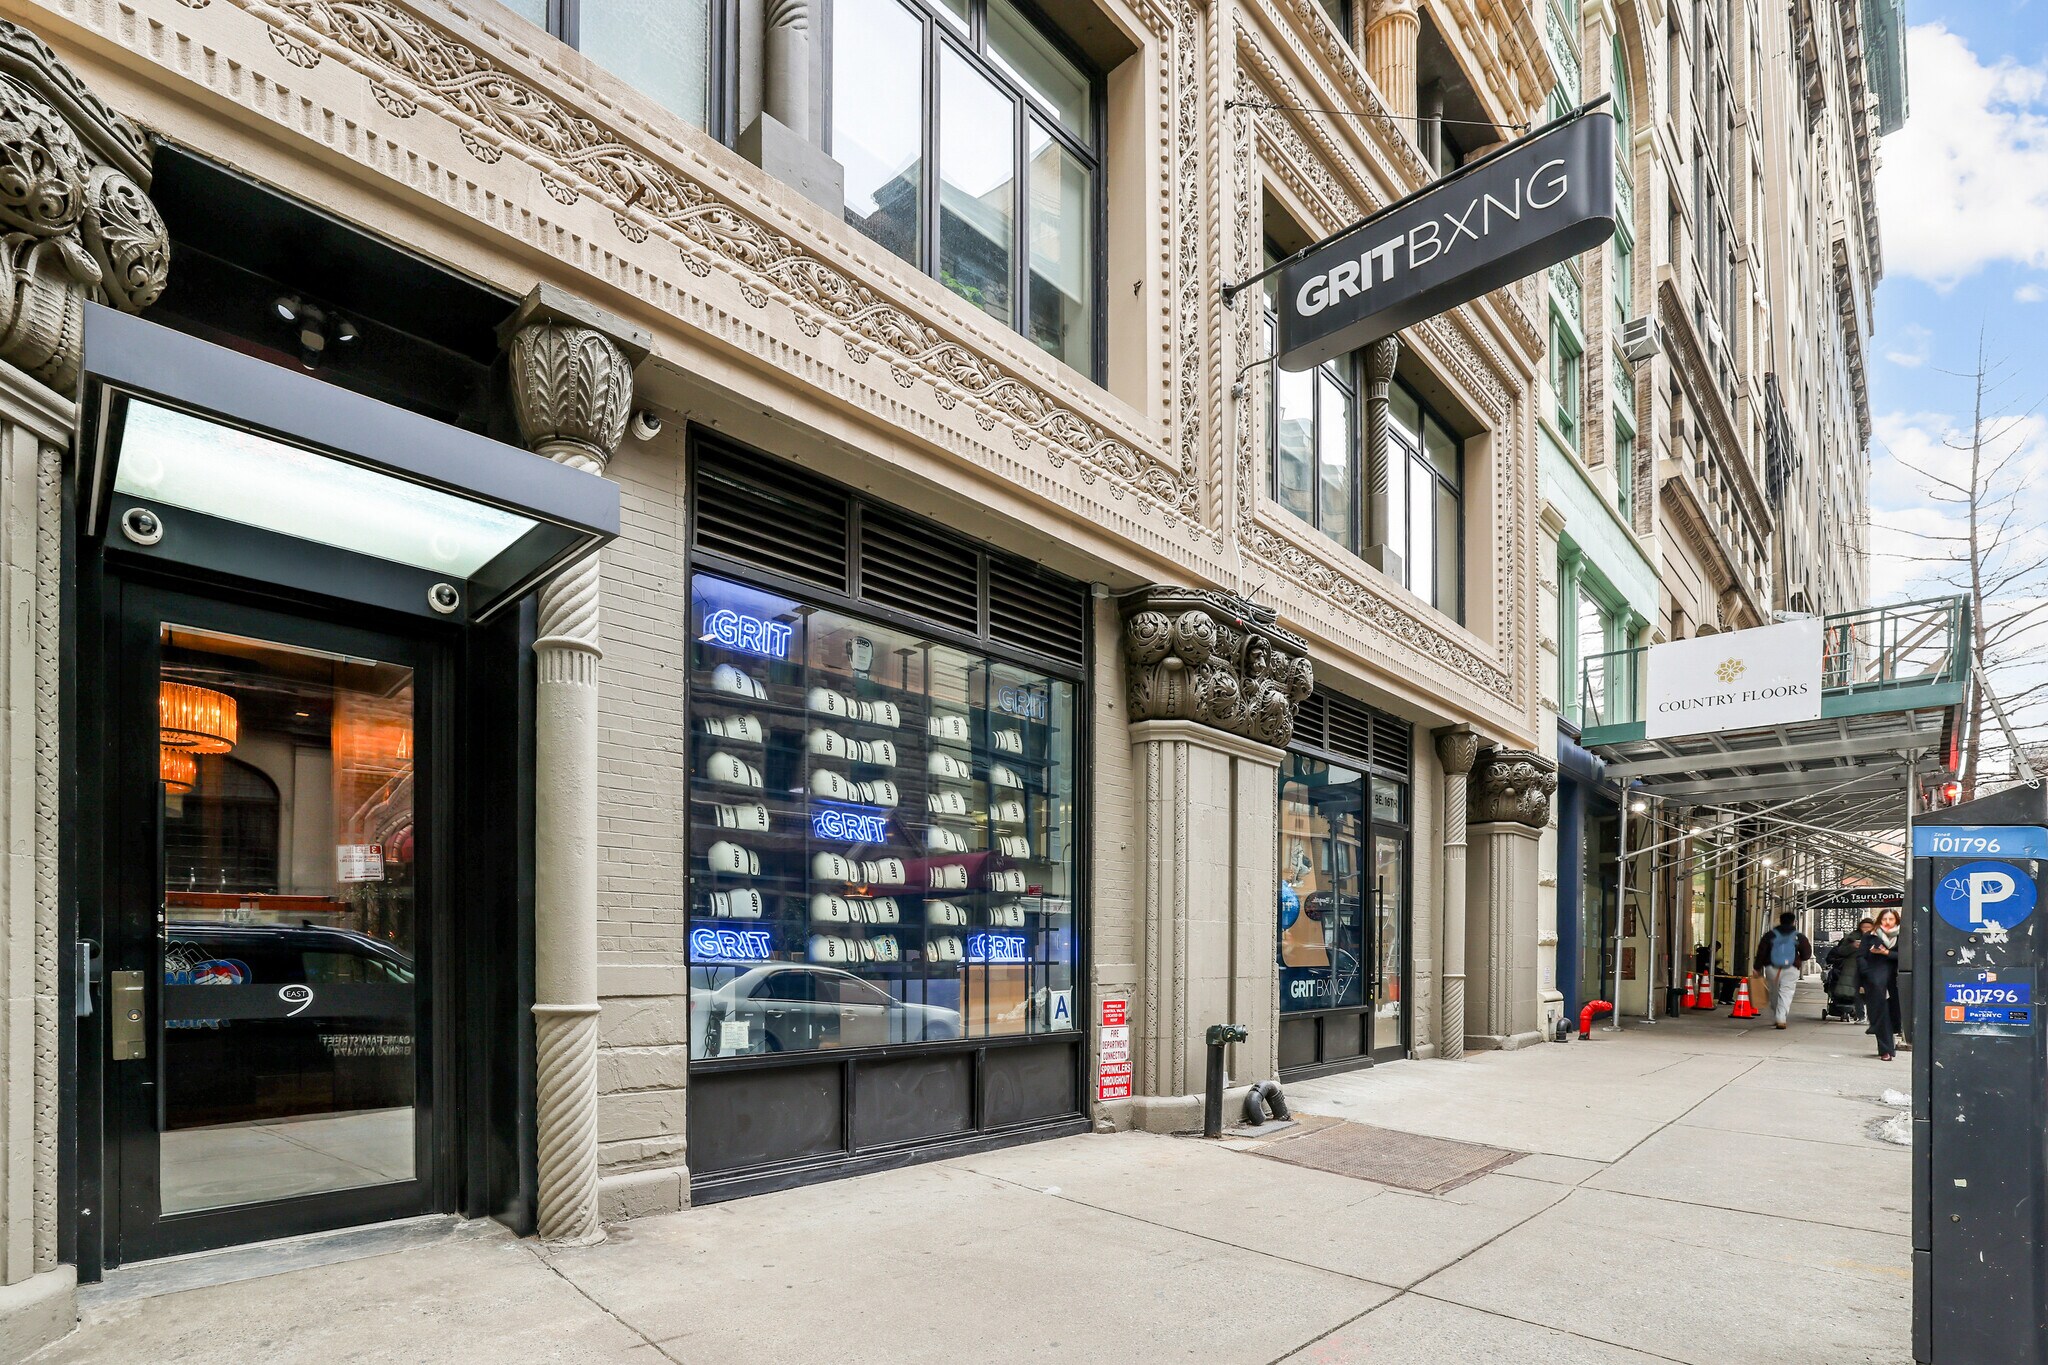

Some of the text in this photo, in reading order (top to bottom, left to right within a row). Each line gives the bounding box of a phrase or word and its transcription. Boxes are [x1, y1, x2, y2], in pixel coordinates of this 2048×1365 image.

[713, 609, 792, 657] GRIT
[998, 685, 1048, 720] GRIT
[1658, 683, 1808, 713] COUNTRY FLOORS
[884, 704, 893, 722] GRIT
[882, 743, 890, 761] GRIT
[884, 783, 892, 801] GRIT
[757, 806, 765, 826] GRIT
[821, 810, 886, 843] GRIT
[1933, 838, 2001, 853] 101796
[889, 862, 897, 879] GRIT
[1970, 872, 2015, 923] P
[886, 901, 894, 919] GRIT
[693, 928, 770, 958] GRIT
[885, 939, 893, 957] GRIT
[977, 933, 1025, 959] GRIT
[1290, 978, 1345, 999] GRIT BXNG
[1956, 989, 2019, 1003] 101796
[1055, 995, 1069, 1019] A
[1110, 1029, 1119, 1038] FIRE
[1102, 1040, 1127, 1050] DEPARTMENT
[1103, 1051, 1126, 1061] CONNECTION
[1101, 1064, 1131, 1075] SPRINKLERS
[1101, 1075, 1130, 1086] THROUGHOUT
[1103, 1086, 1127, 1098] BUILDING
